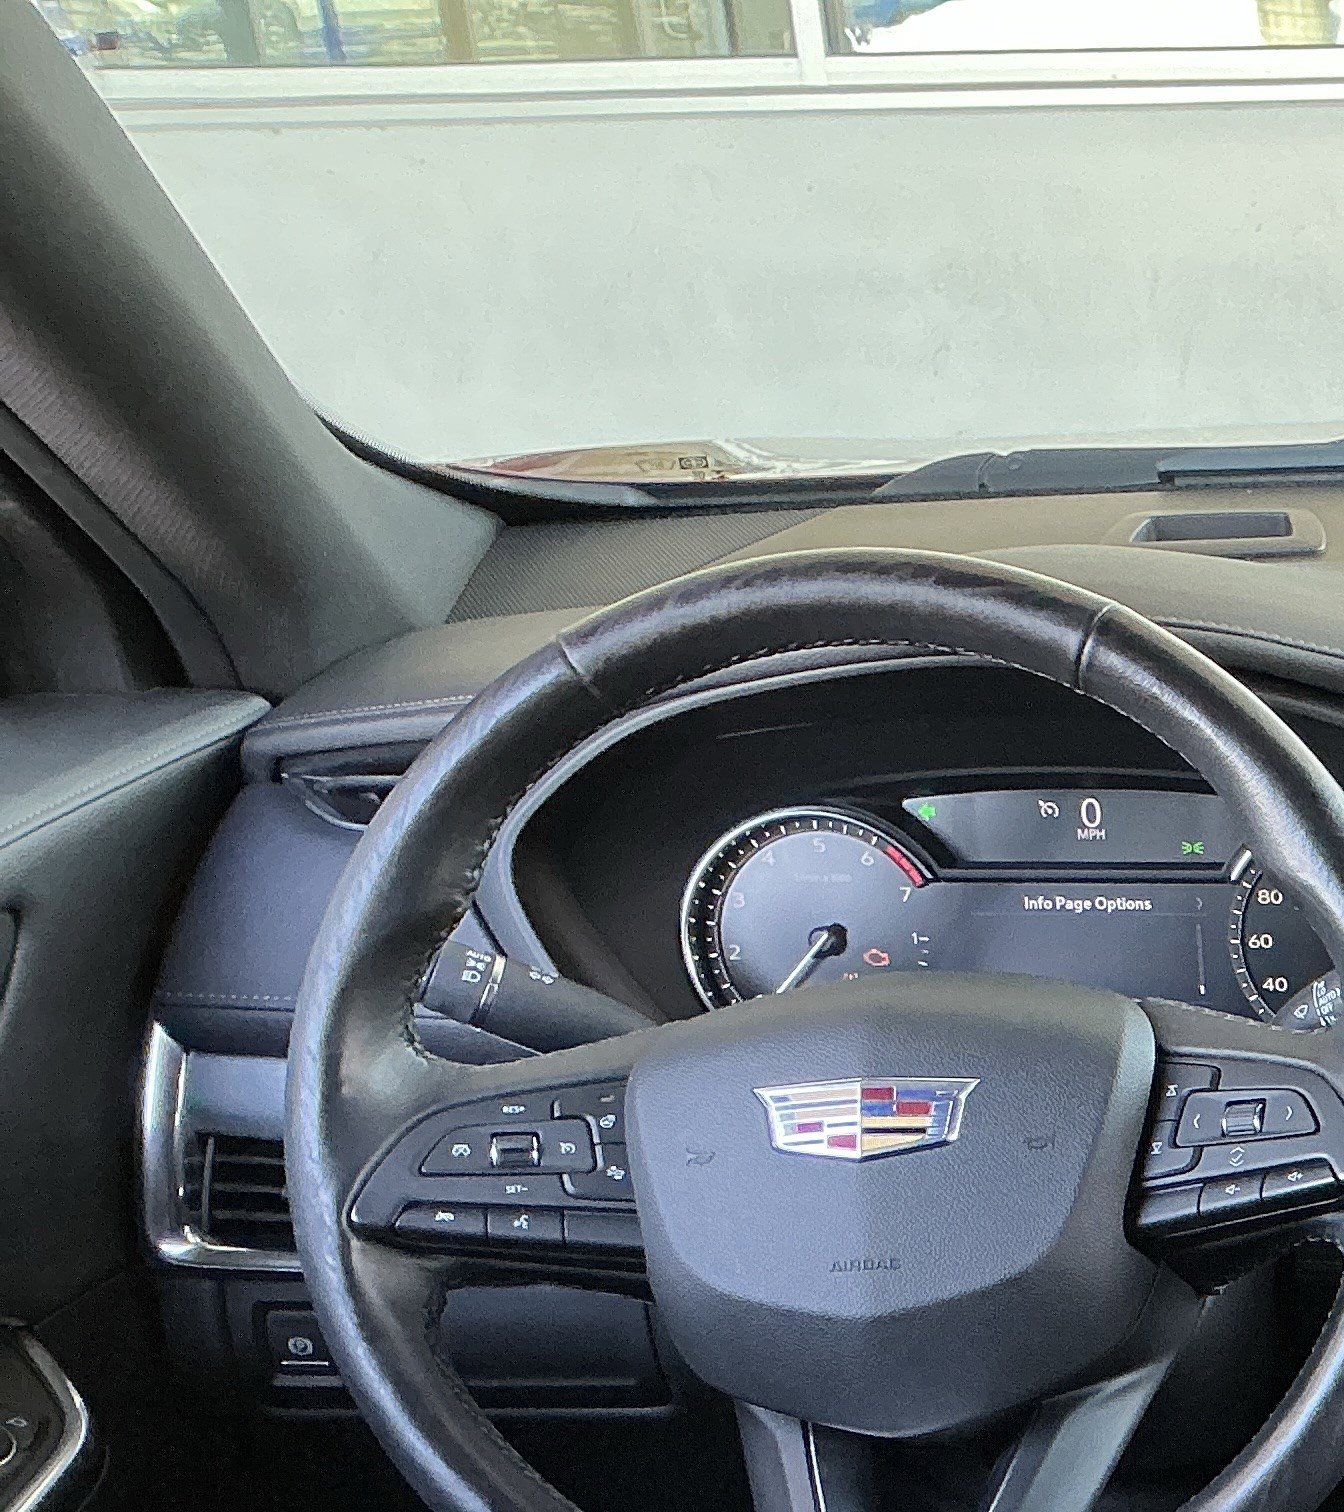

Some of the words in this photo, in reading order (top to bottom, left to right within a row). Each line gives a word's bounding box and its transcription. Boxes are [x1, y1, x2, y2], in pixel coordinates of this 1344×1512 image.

[1080, 797, 1102, 828] 0
[1077, 828, 1106, 841] MPH
[812, 839, 826, 853] 5
[761, 850, 775, 866] 4
[861, 850, 875, 866] 6
[731, 891, 745, 908] 3
[899, 886, 912, 902] 7
[1257, 890, 1283, 905] 80
[1023, 896, 1053, 911] Info
[1055, 896, 1092, 914] Page
[1094, 896, 1153, 914] Options
[1248, 933, 1273, 949] 60
[729, 944, 742, 961] 2
[1262, 977, 1288, 992] 40
